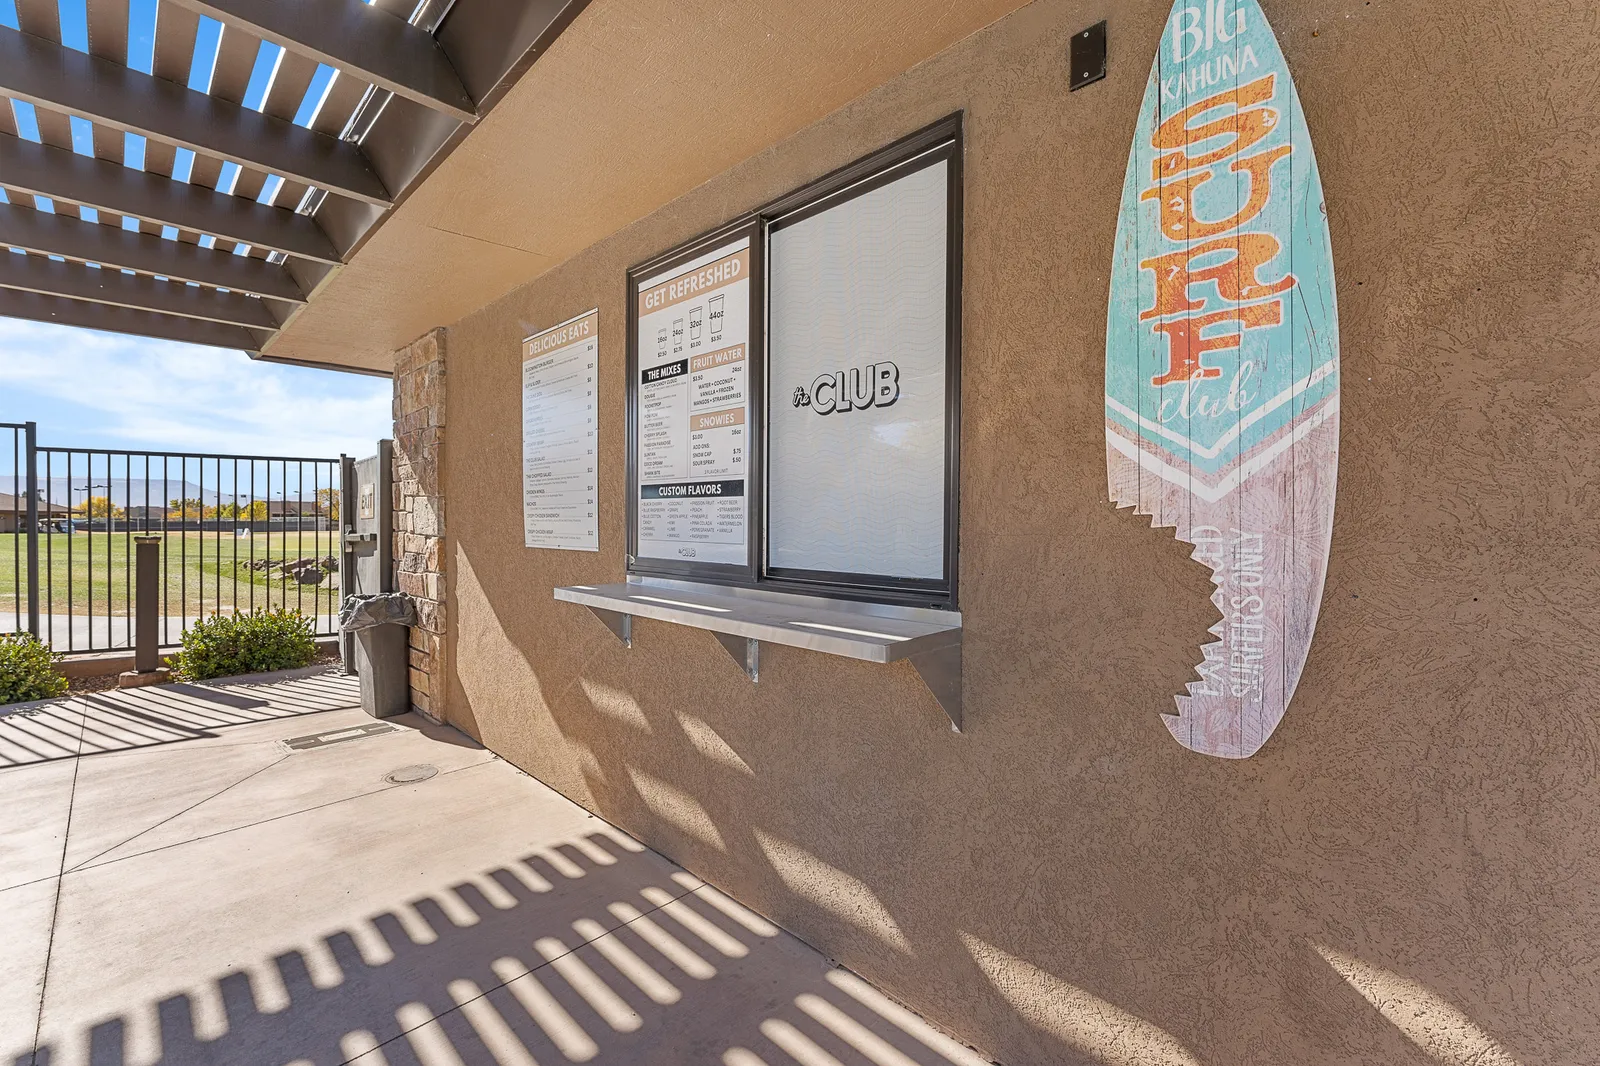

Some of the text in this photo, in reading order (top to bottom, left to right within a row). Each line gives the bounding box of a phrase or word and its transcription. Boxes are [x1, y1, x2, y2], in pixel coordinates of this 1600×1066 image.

[1172, 0, 1248, 64] BIG
[1159, 44, 1259, 104] KAHUNA
[1139, 71, 1299, 387] SURF
[646, 259, 741, 310] GET REFRESHED
[709, 310, 724, 320] 44oz
[672, 329, 684, 337] 24oz
[690, 320, 702, 329] 32oz
[529, 320, 589, 356] DELICIOUS EATS
[711, 334, 722, 342] $3.50
[694, 348, 742, 369] FRUIT WATER
[648, 364, 681, 380] THE MIXES
[714, 377, 733, 386] COCONUT
[793, 361, 900, 416] the CLUB
[712, 392, 742, 403] STRAWBERRIES
[1157, 360, 1258, 424] club
[700, 413, 734, 428] SNOWIES
[658, 484, 721, 496] CUSTOM FLAVORS
[1230, 527, 1264, 702] SURFERS ONLY
